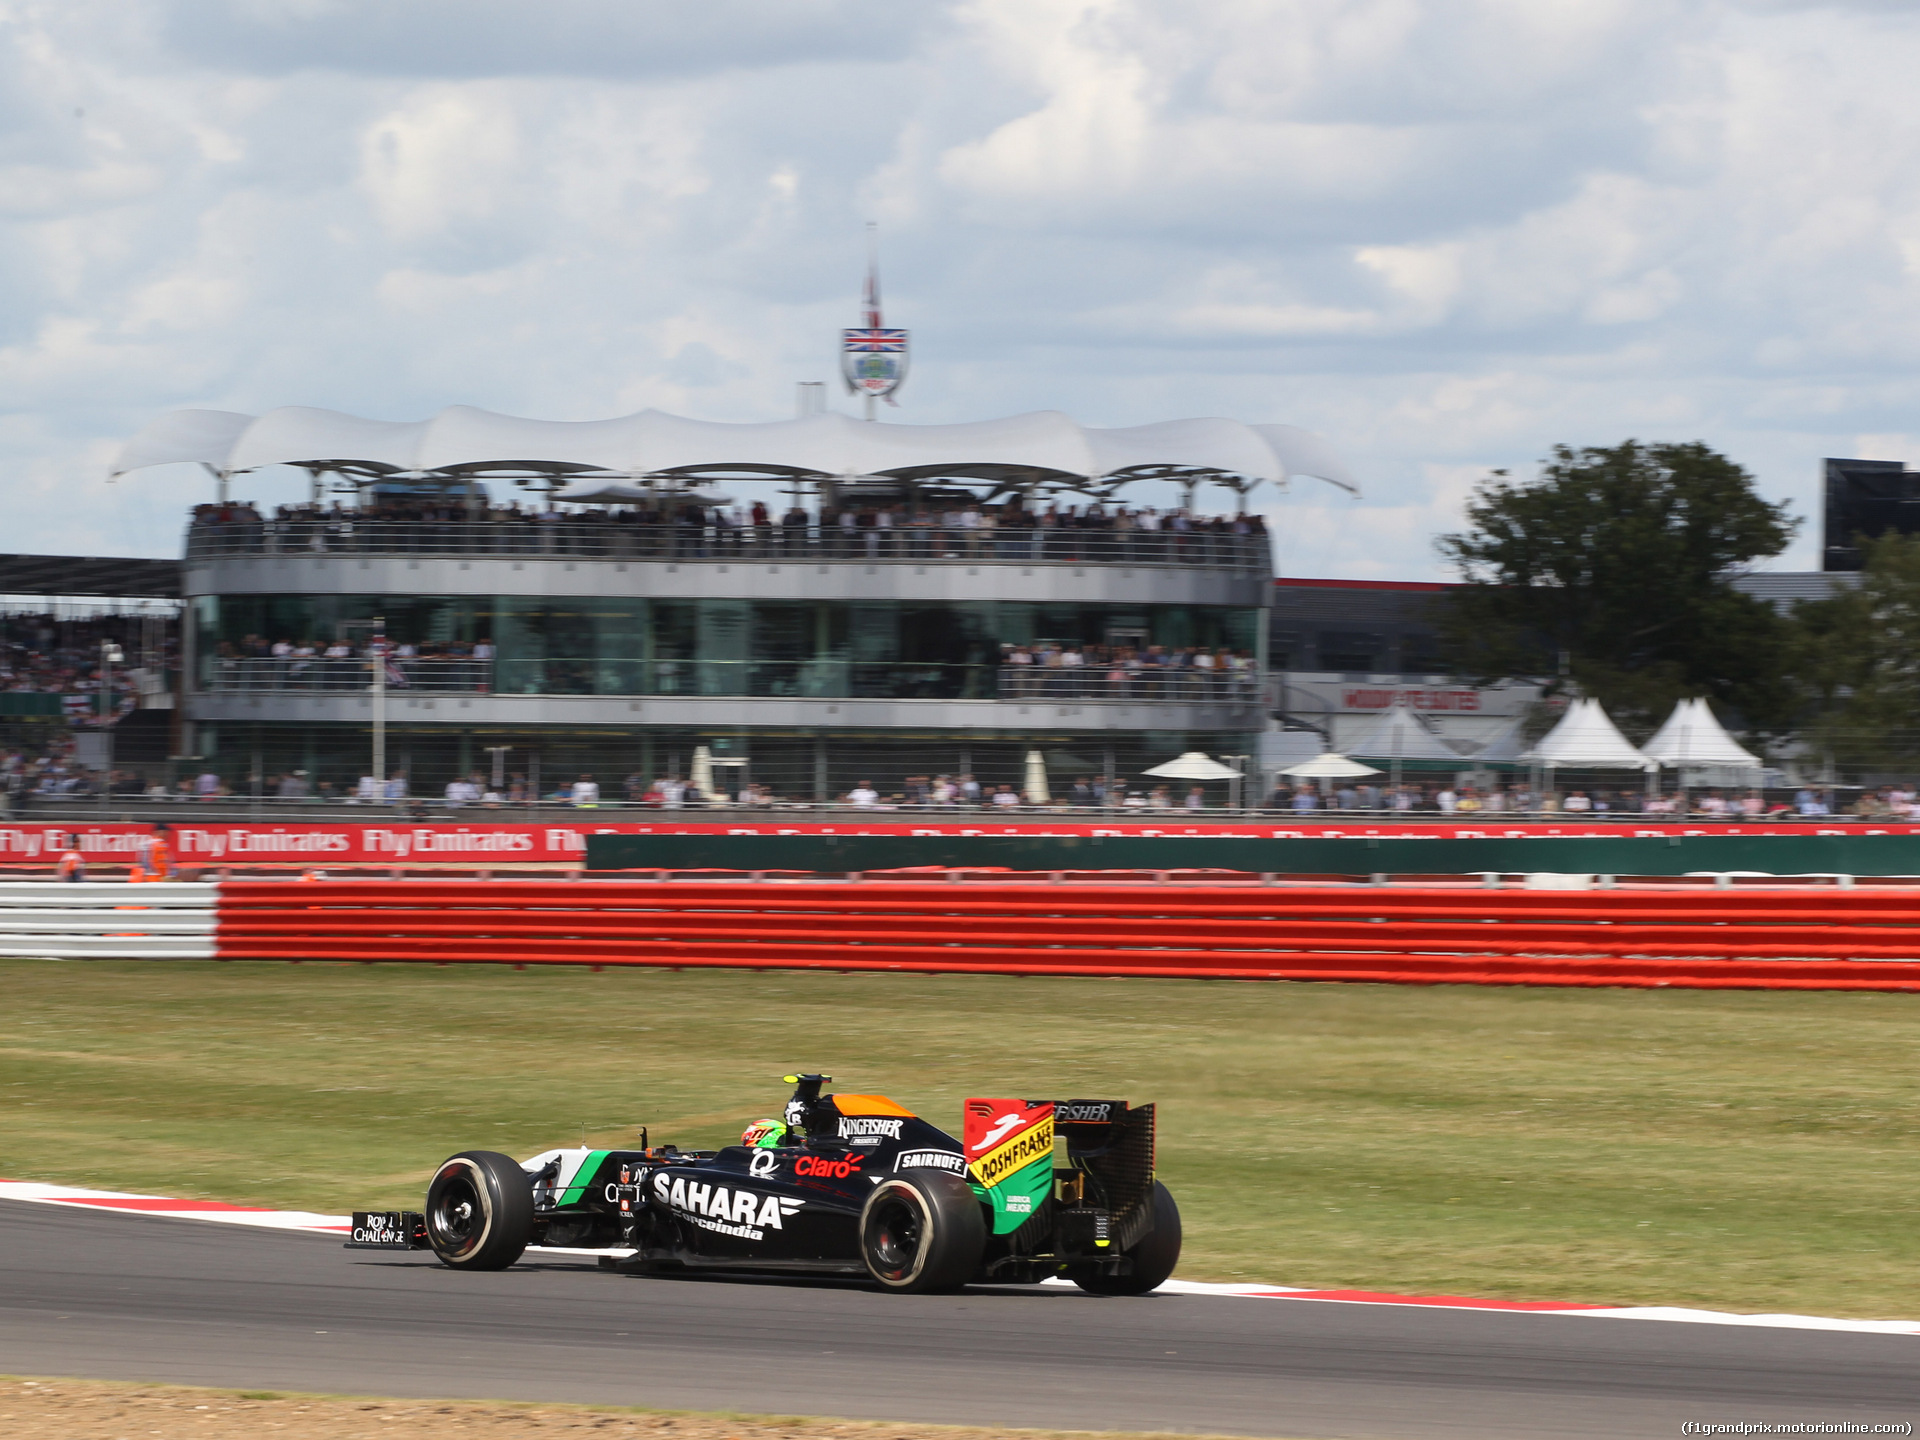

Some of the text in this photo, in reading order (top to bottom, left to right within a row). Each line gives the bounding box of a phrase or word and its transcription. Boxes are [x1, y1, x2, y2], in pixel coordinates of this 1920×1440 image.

[178, 828, 350, 857] Fly Emirates
[362, 828, 533, 857] Fly Emirates
[837, 1117, 904, 1140] KINGFISHER
[795, 1154, 854, 1178] Claro
[902, 1153, 960, 1171] SMIRNOFF
[982, 1125, 1051, 1183] ROSHFRANS
[653, 1172, 783, 1230] SAHARA
